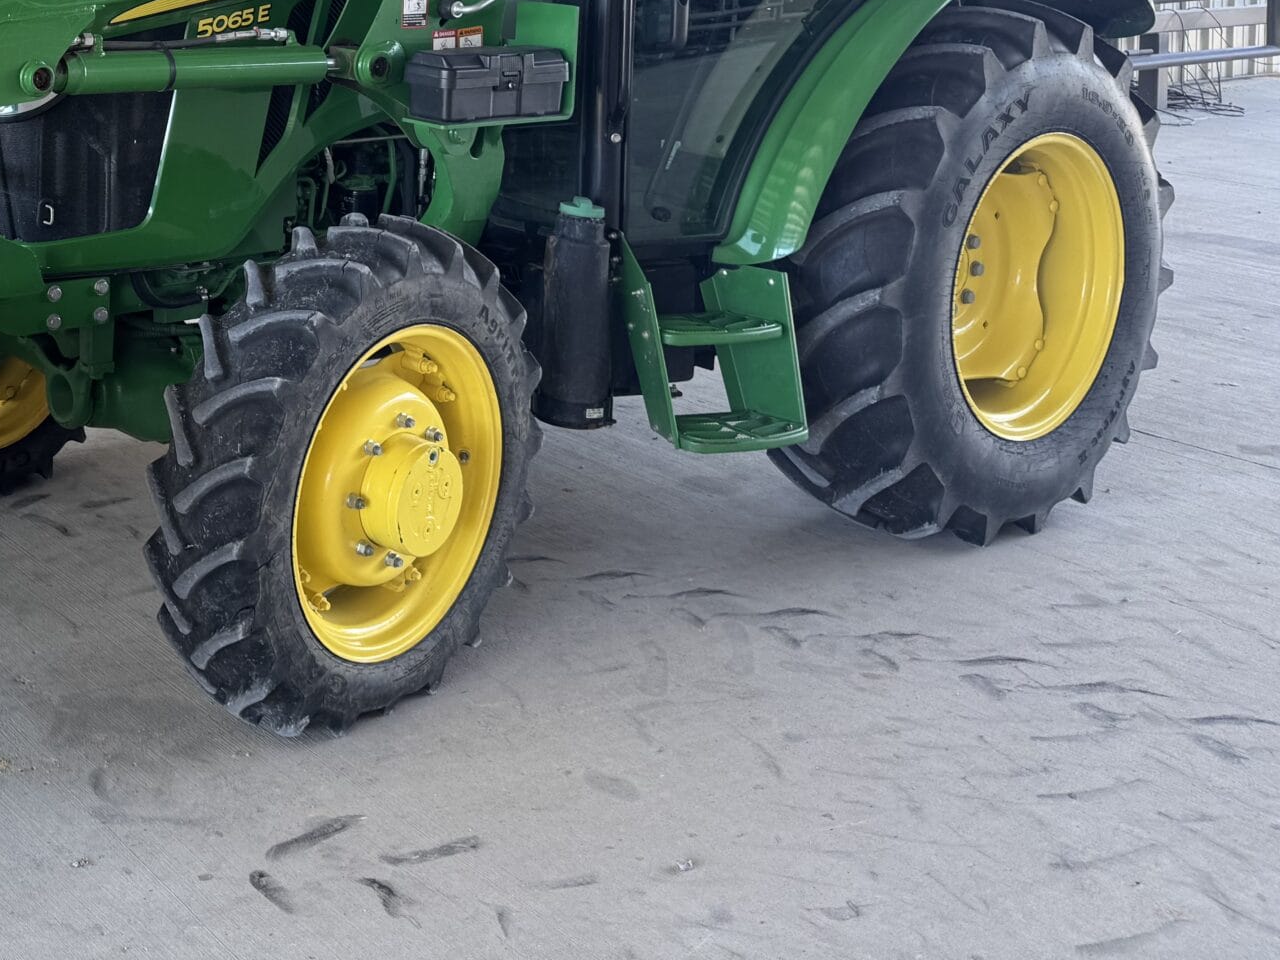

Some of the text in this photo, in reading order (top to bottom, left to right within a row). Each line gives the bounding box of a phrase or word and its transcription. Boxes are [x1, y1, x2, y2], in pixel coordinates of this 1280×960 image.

[197, 4, 271, 39] 5065 E
[943, 84, 1036, 229] GALAXY
